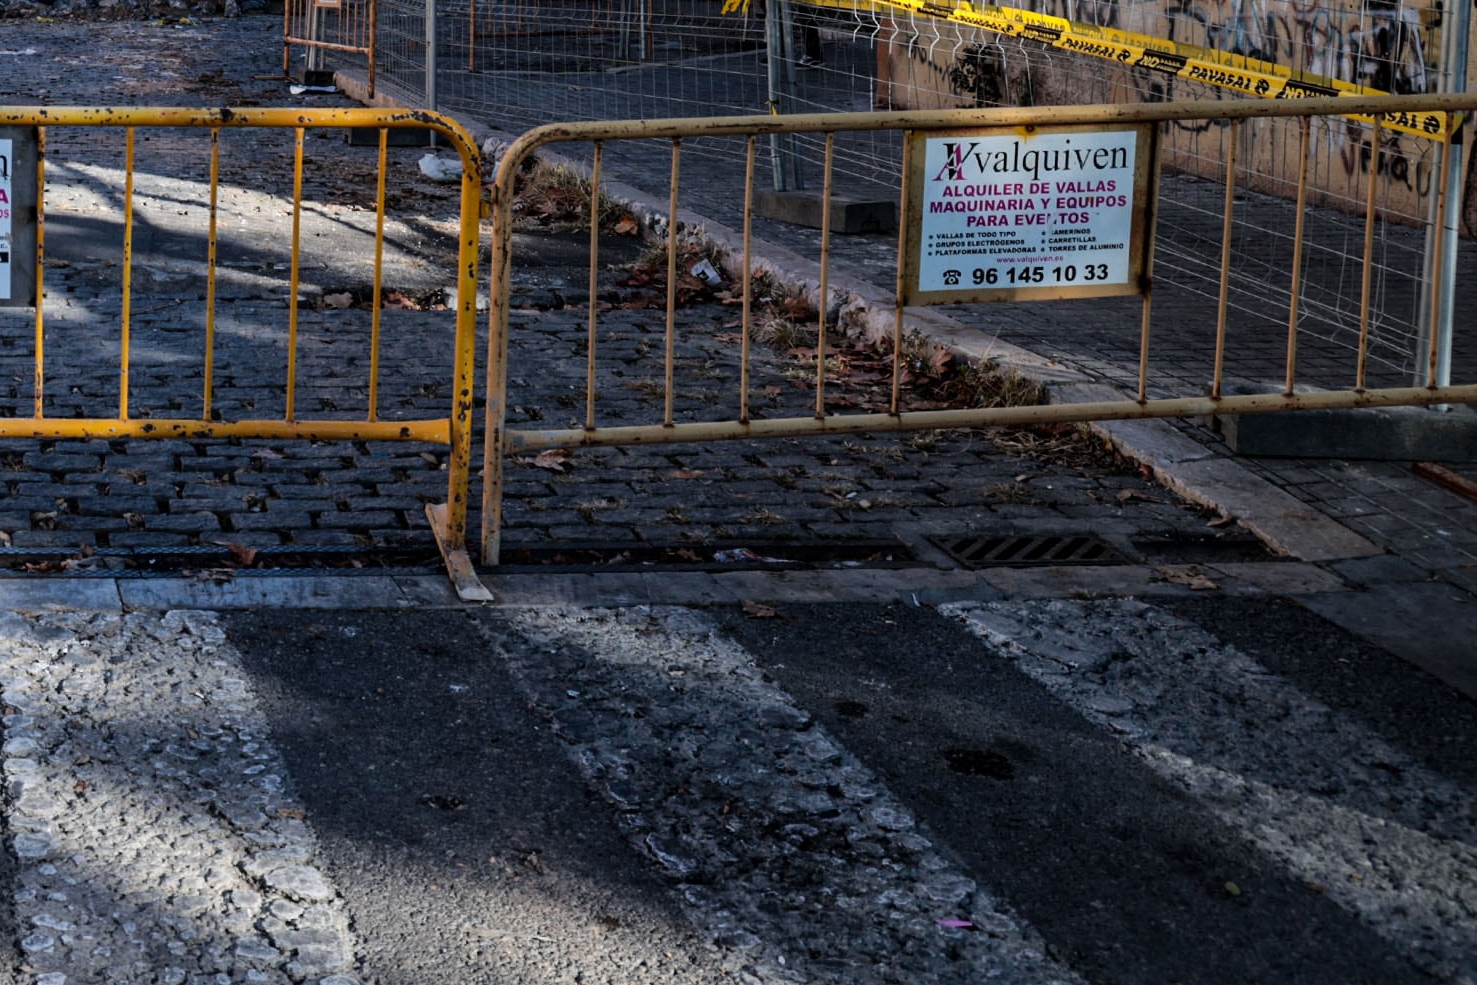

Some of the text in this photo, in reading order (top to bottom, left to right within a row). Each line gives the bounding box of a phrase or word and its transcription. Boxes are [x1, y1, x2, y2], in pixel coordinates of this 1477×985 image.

[1062, 38, 1115, 57] PAVASAL
[1140, 56, 1159, 68] NO
[1189, 66, 1252, 90] PAVASAL
[973, 139, 1128, 180] valquiven
[942, 180, 1117, 197] ALQUILER DE VALLAS
[929, 195, 1127, 213] MAQUINARIA Y EQUIPOS
[967, 215, 1009, 227] PARA
[1048, 236, 1096, 244] CARRETILLAS
[1049, 244, 1076, 252] TORRES
[1089, 242, 1124, 250] ALUMINIO
[935, 246, 1037, 256] PLATAFORMAS ELEVADORAS
[972, 264, 1108, 285] 96 145 10 33
